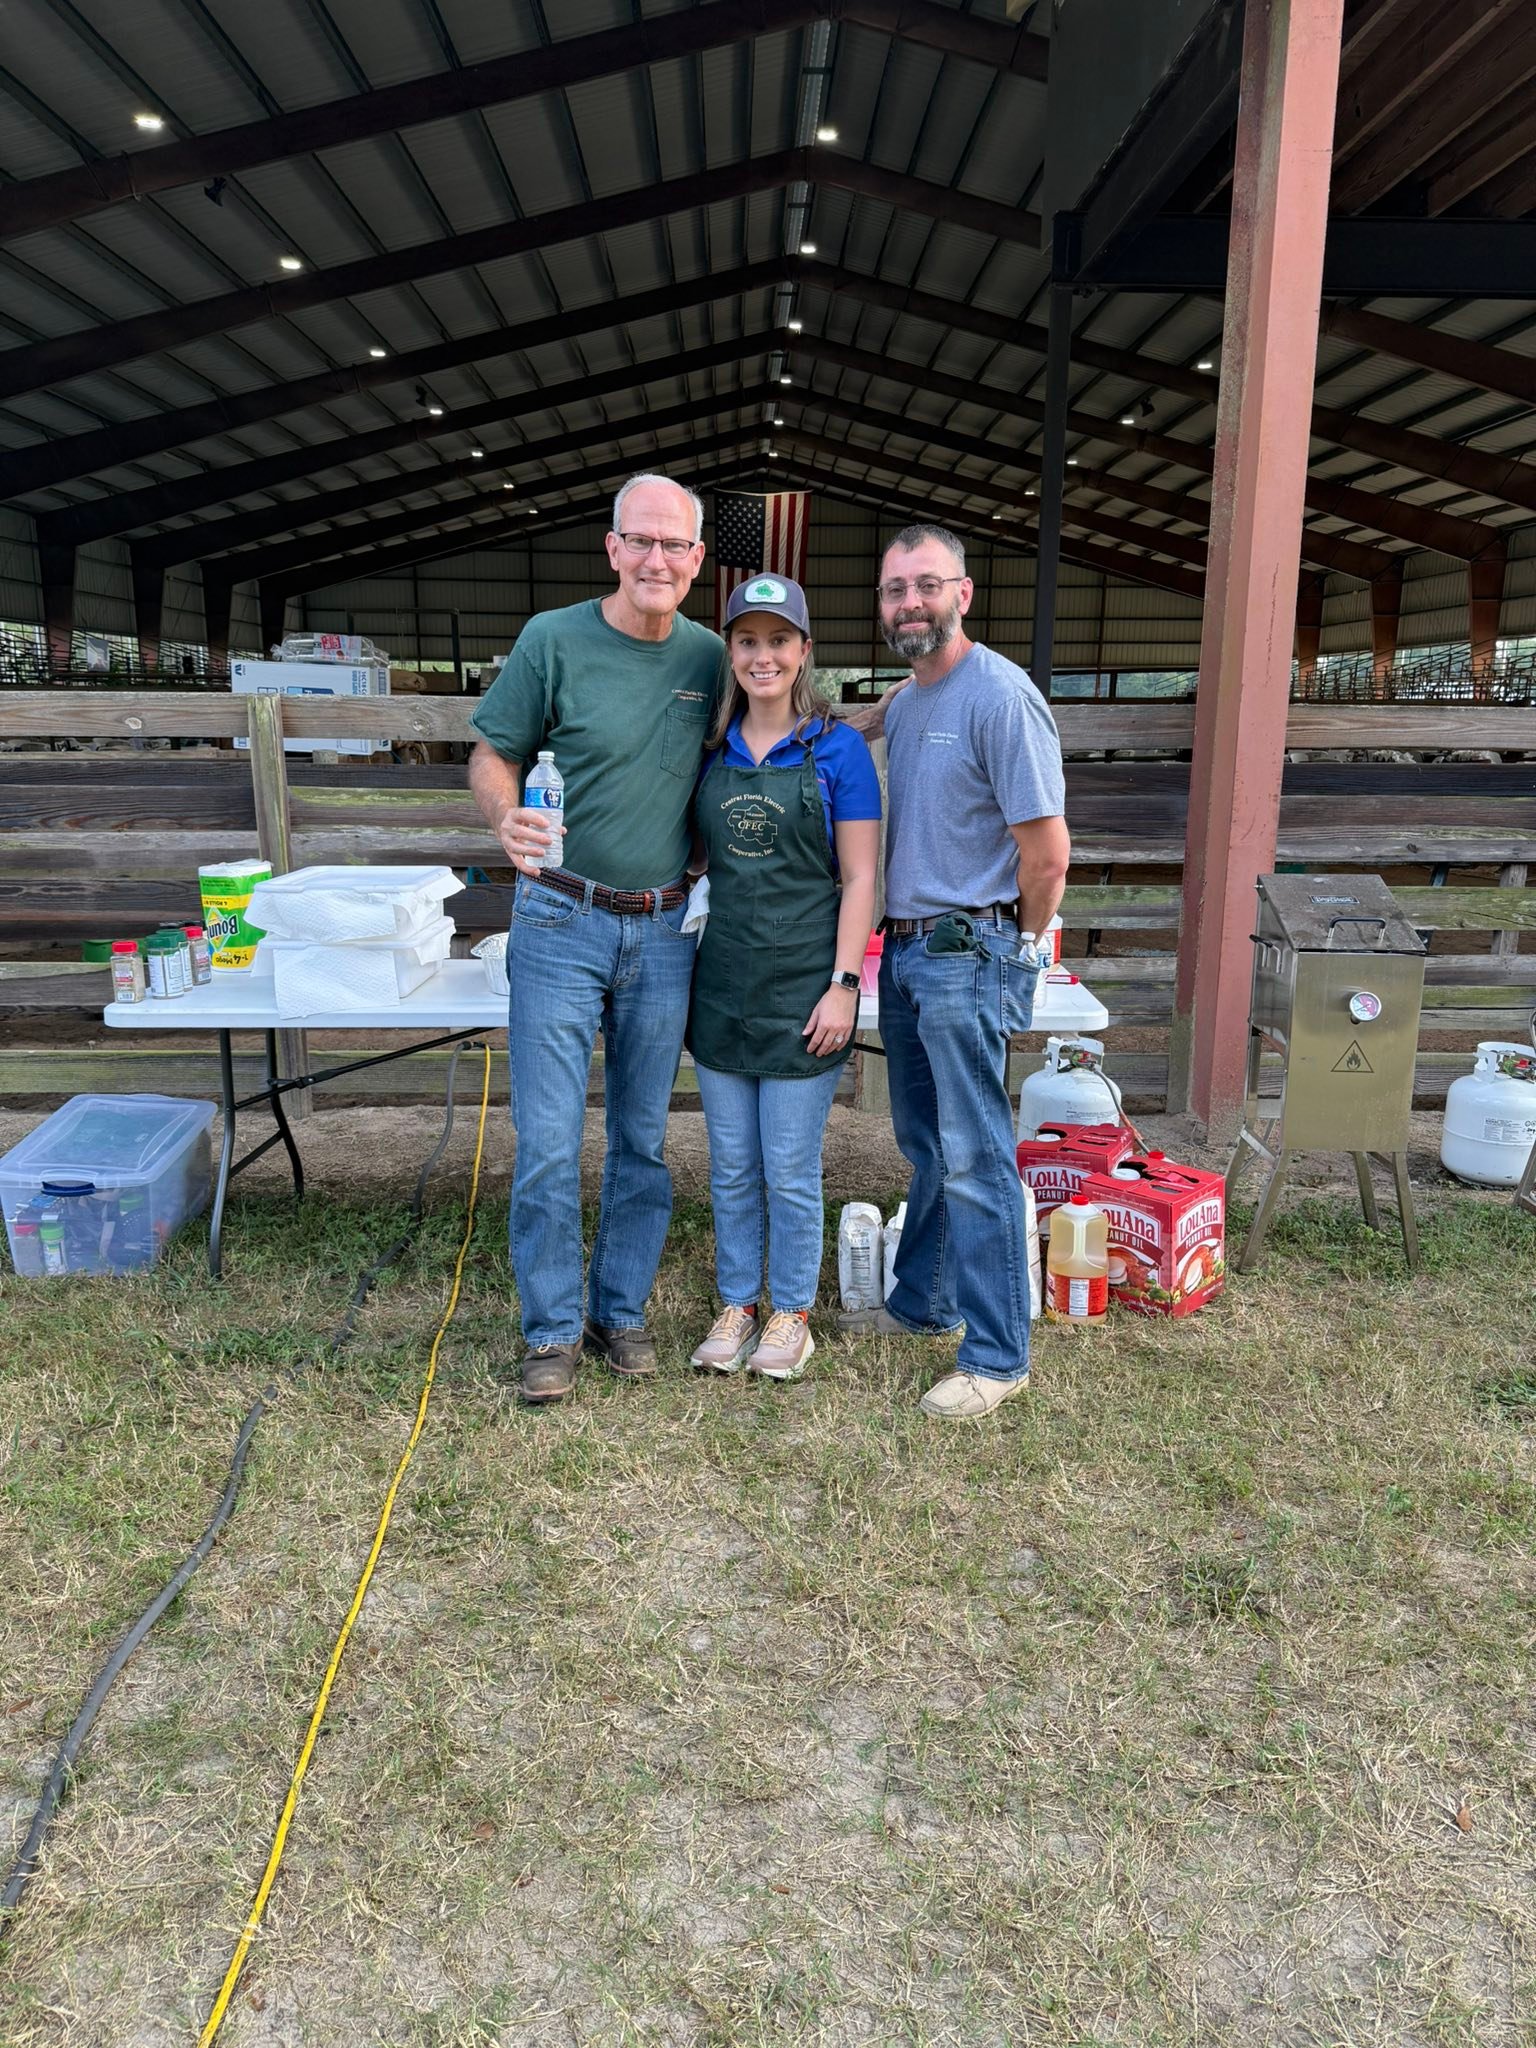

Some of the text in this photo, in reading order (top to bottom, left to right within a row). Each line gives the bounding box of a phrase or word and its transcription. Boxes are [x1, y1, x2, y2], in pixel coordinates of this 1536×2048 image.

[720, 793, 786, 814] Central Florida Electric
[737, 820, 766, 831] CFEC
[728, 843, 776, 858] Cooperative, Inc.
[207, 914, 239, 939] Boun
[1027, 1169, 1082, 1191] LouAn
[1037, 1190, 1066, 1200] PEANUT
[1101, 1208, 1155, 1243] ouAna
[1179, 1204, 1219, 1242] LouAna
[1131, 1235, 1145, 1250] OIL
